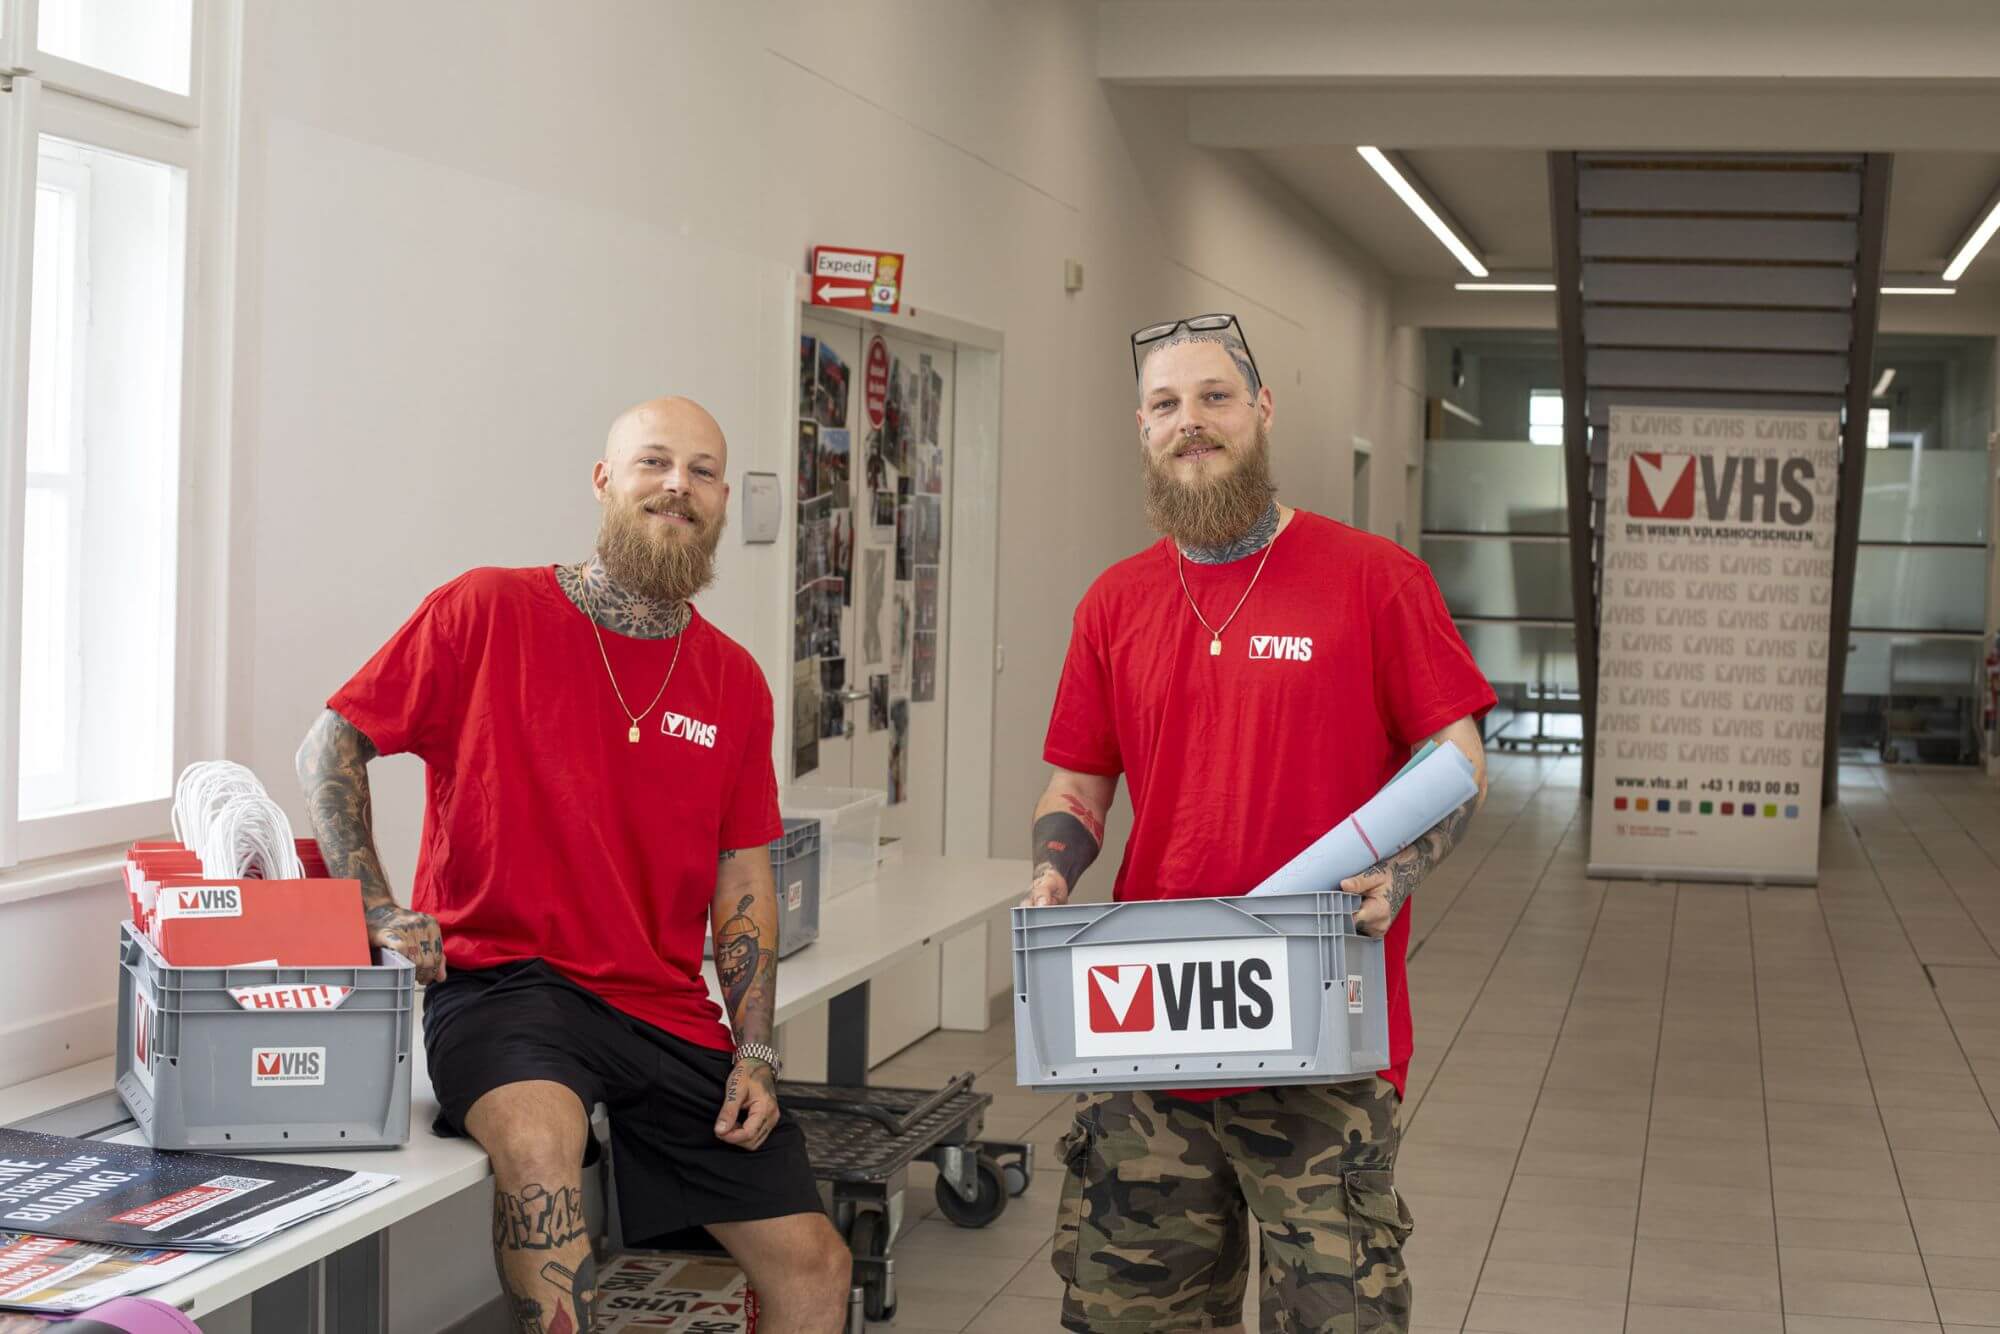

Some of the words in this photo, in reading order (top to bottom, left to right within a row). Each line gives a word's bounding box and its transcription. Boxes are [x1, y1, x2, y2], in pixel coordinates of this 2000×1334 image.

[818, 256, 873, 275] Expedit
[1700, 454, 1816, 526] VHS
[1626, 524, 1643, 537] DIE
[1647, 525, 1691, 538] WIENER
[1695, 527, 1813, 543] VOLKSHOCHSCHULEN
[1273, 636, 1313, 662] VHS
[685, 717, 718, 748] VHS
[1615, 776, 1689, 790] www.vhs.at
[1700, 779, 1722, 792] +43
[1728, 780, 1734, 792] 1
[1738, 780, 1761, 793] 893
[1765, 781, 1781, 794] 00
[1784, 782, 1800, 795] 83
[200, 890, 237, 909] VHS
[1156, 958, 1274, 1031] VHS
[281, 1052, 319, 1075] VHS
[0, 1173, 75, 1203] STEHEN
[56, 1156, 107, 1173] AUF
[4, 1170, 139, 1221] BILDUNG!
[607, 1296, 688, 1313] VHS
